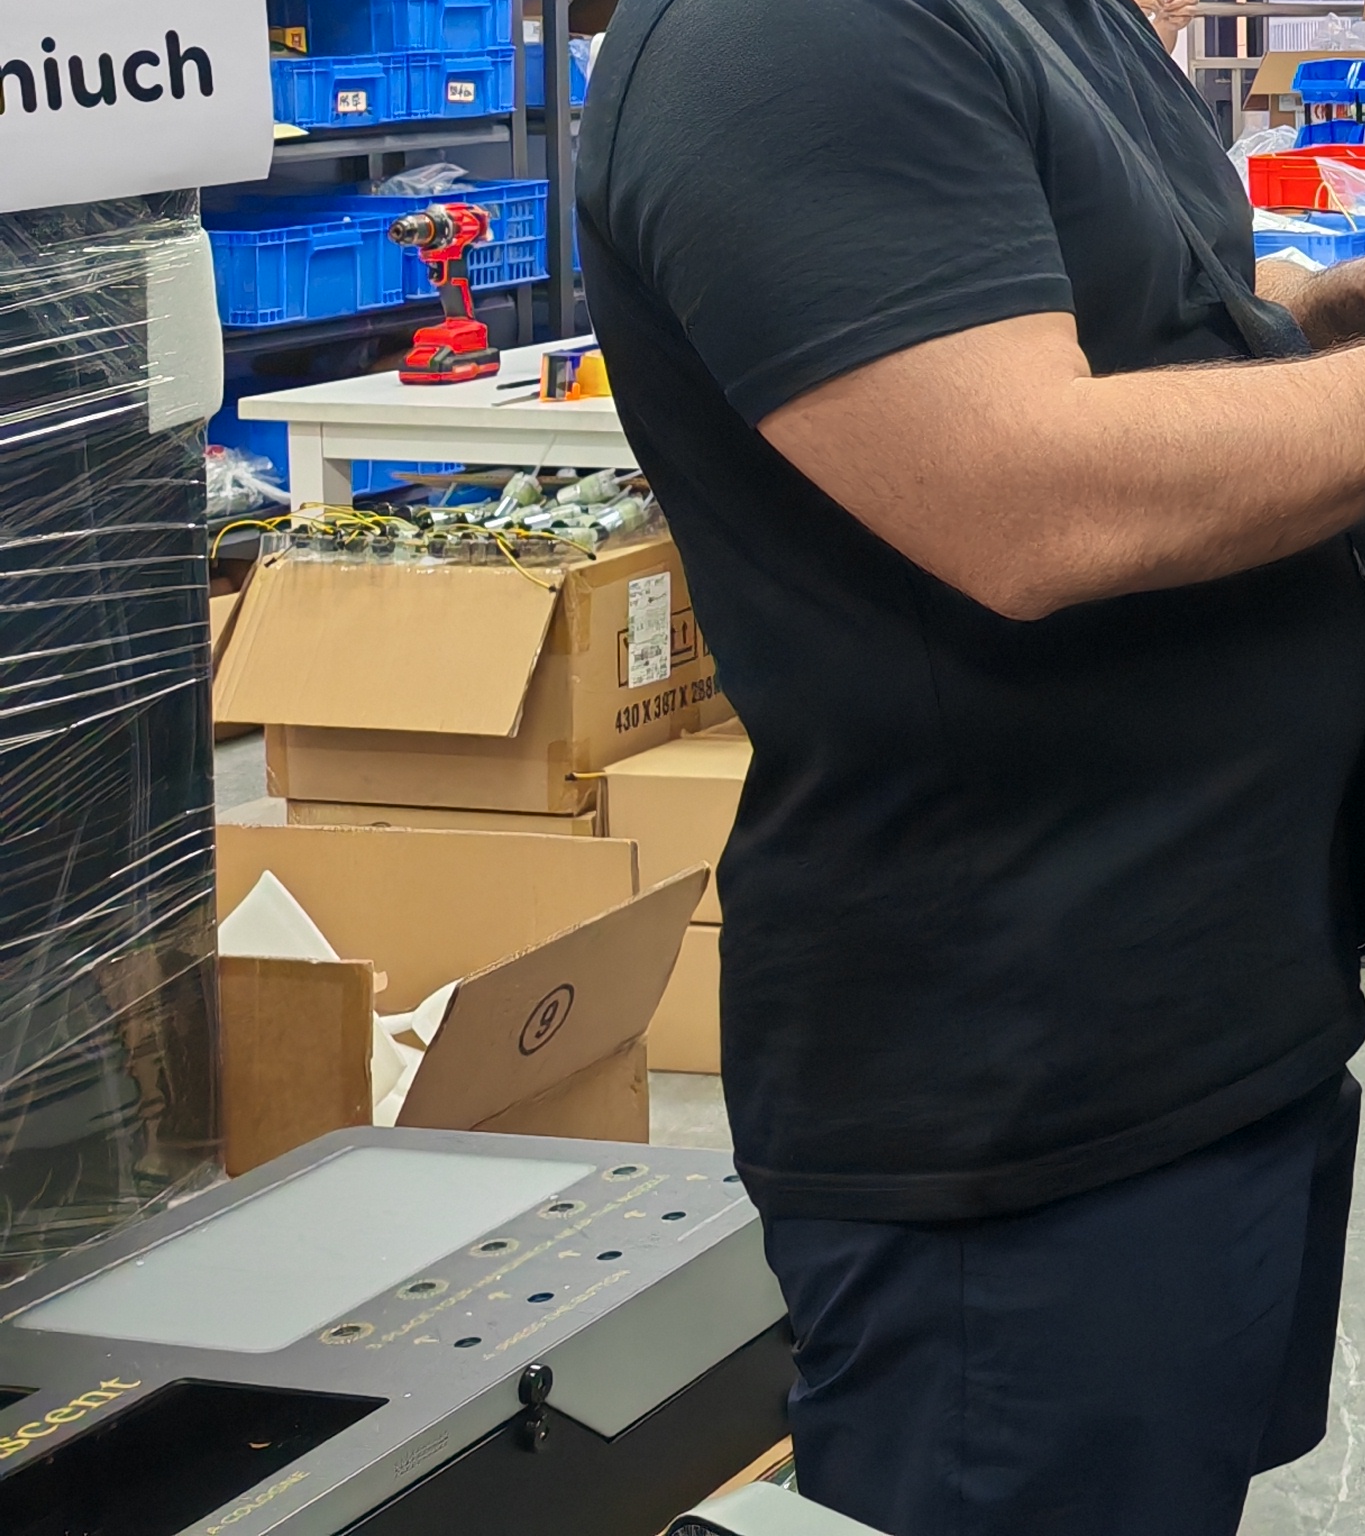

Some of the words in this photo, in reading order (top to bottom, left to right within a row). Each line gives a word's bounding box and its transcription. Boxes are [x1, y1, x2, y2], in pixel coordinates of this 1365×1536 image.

[615, 702, 639, 733] 430
[643, 698, 652, 724] X
[679, 685, 688, 708] X
